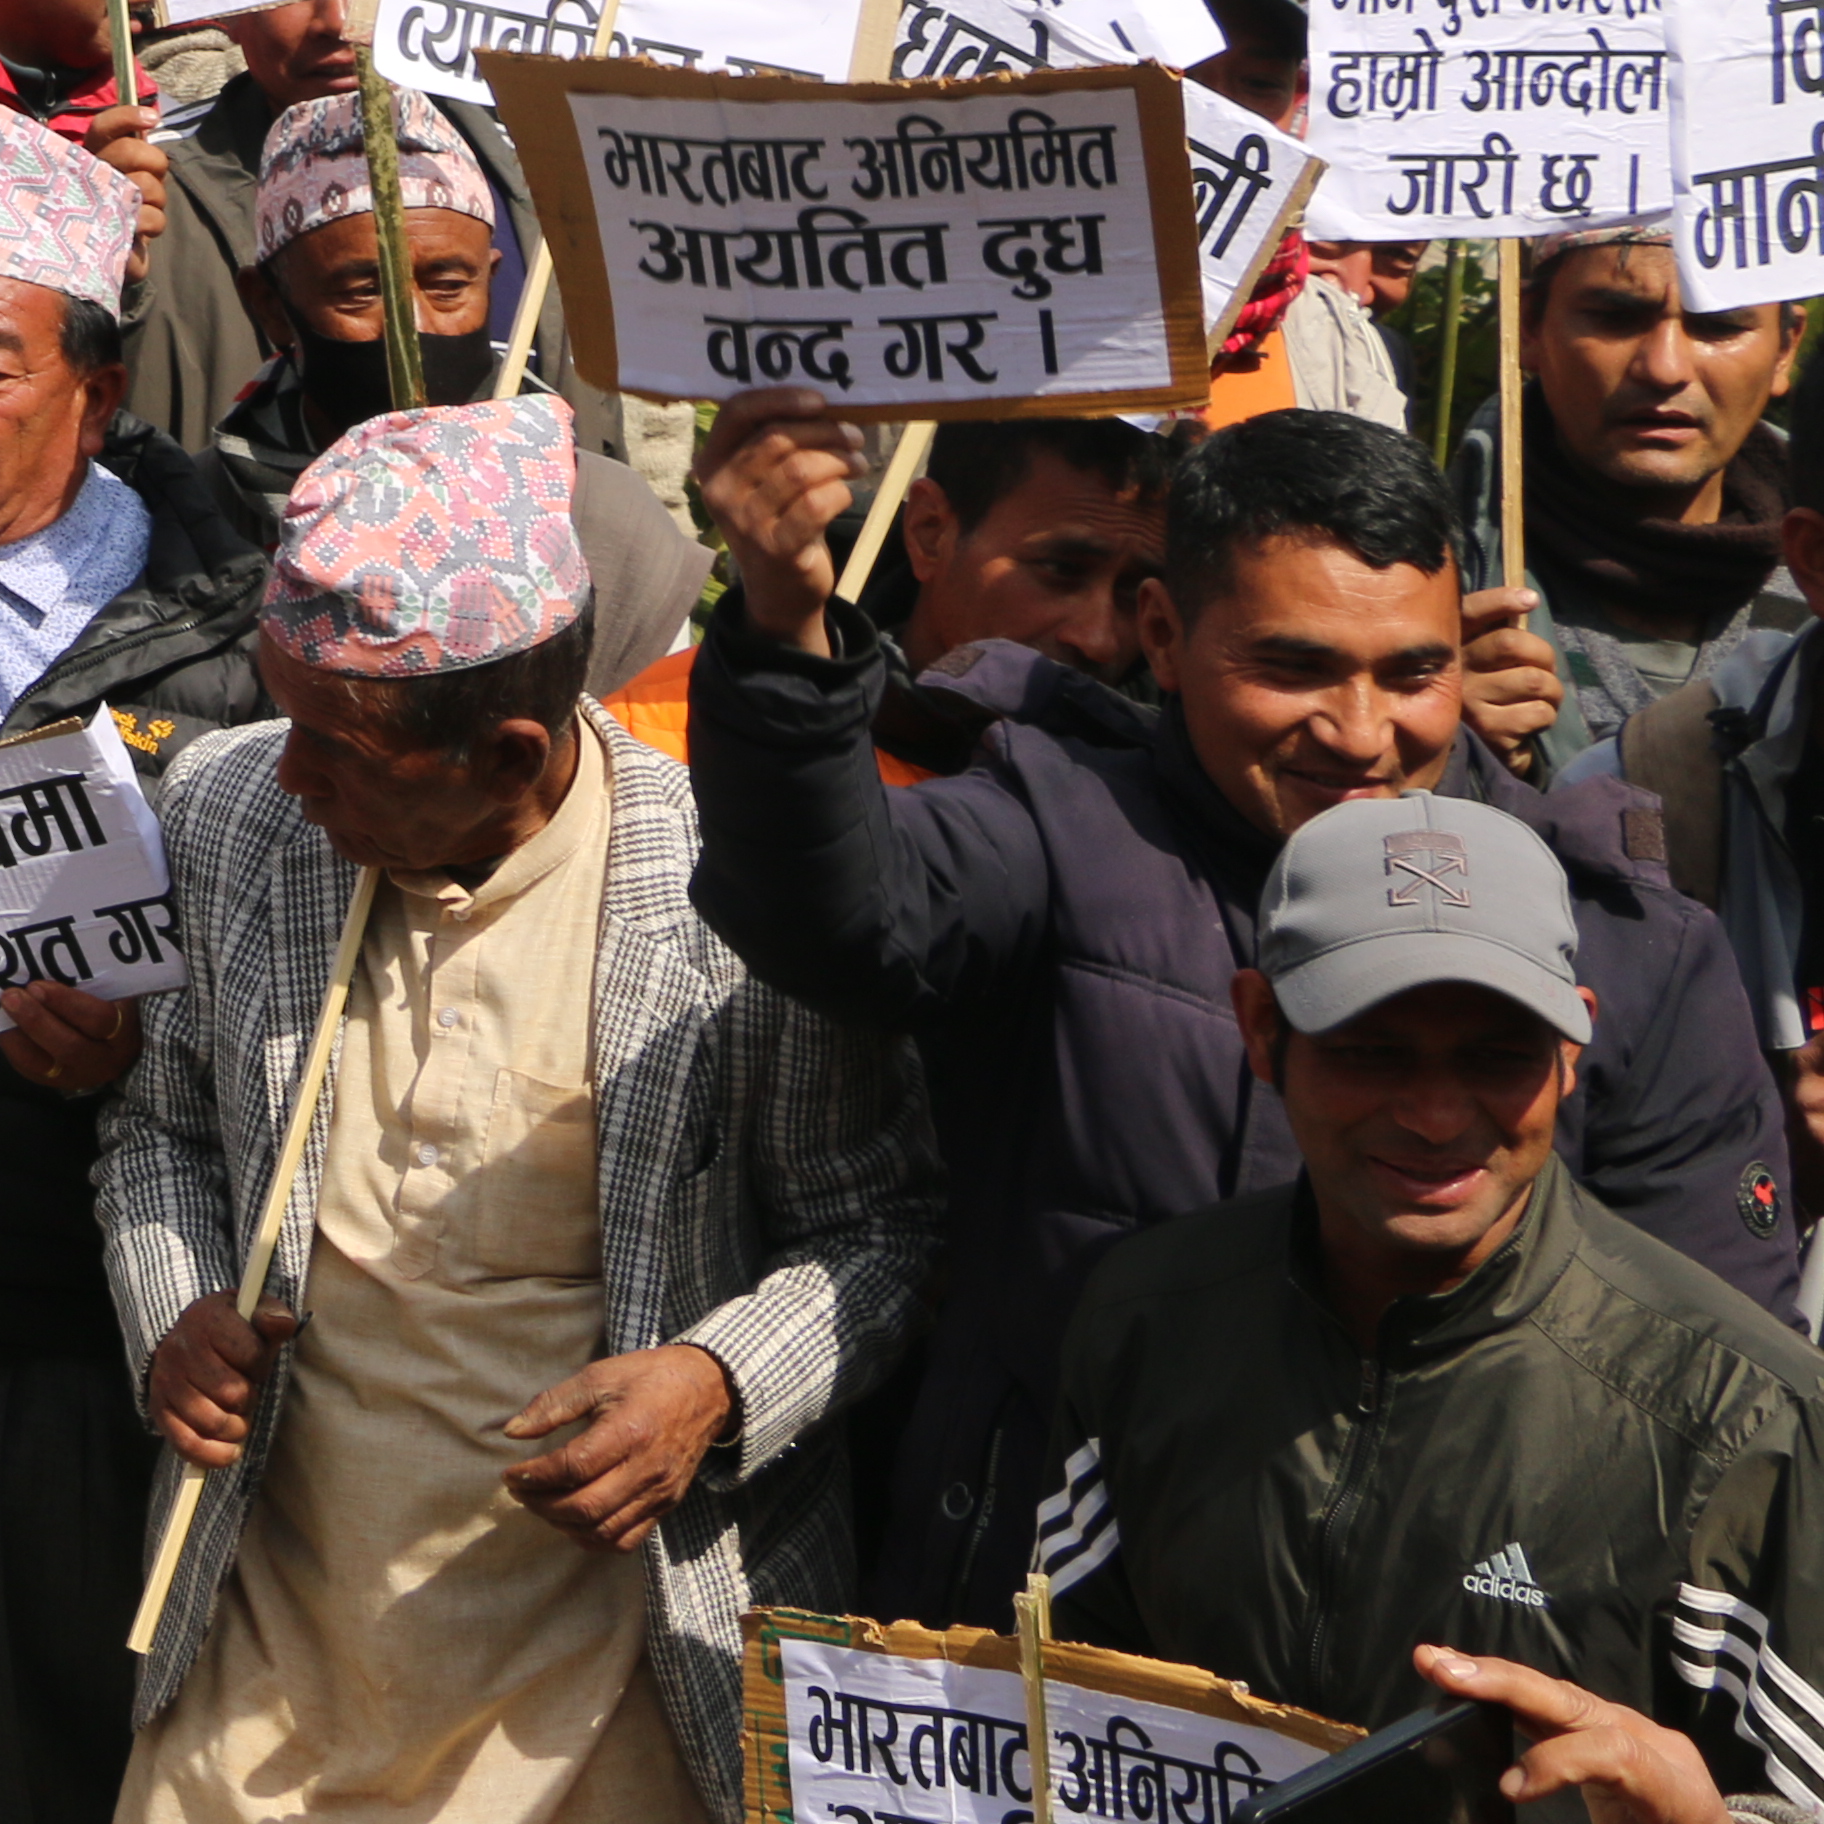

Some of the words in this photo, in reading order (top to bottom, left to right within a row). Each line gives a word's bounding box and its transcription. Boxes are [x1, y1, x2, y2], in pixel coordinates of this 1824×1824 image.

[1326, 26, 1443, 122] हाम्रो
[599, 125, 828, 208] भारतबाट
[845, 108, 1119, 200] अनियमित
[1387, 131, 1519, 220] जारी
[1540, 154, 1599, 218] छ
[977, 214, 1106, 301] दुध
[702, 314, 853, 393] वन्द
[881, 310, 999, 382] गर
[1462, 1573, 1545, 1607] adidas
